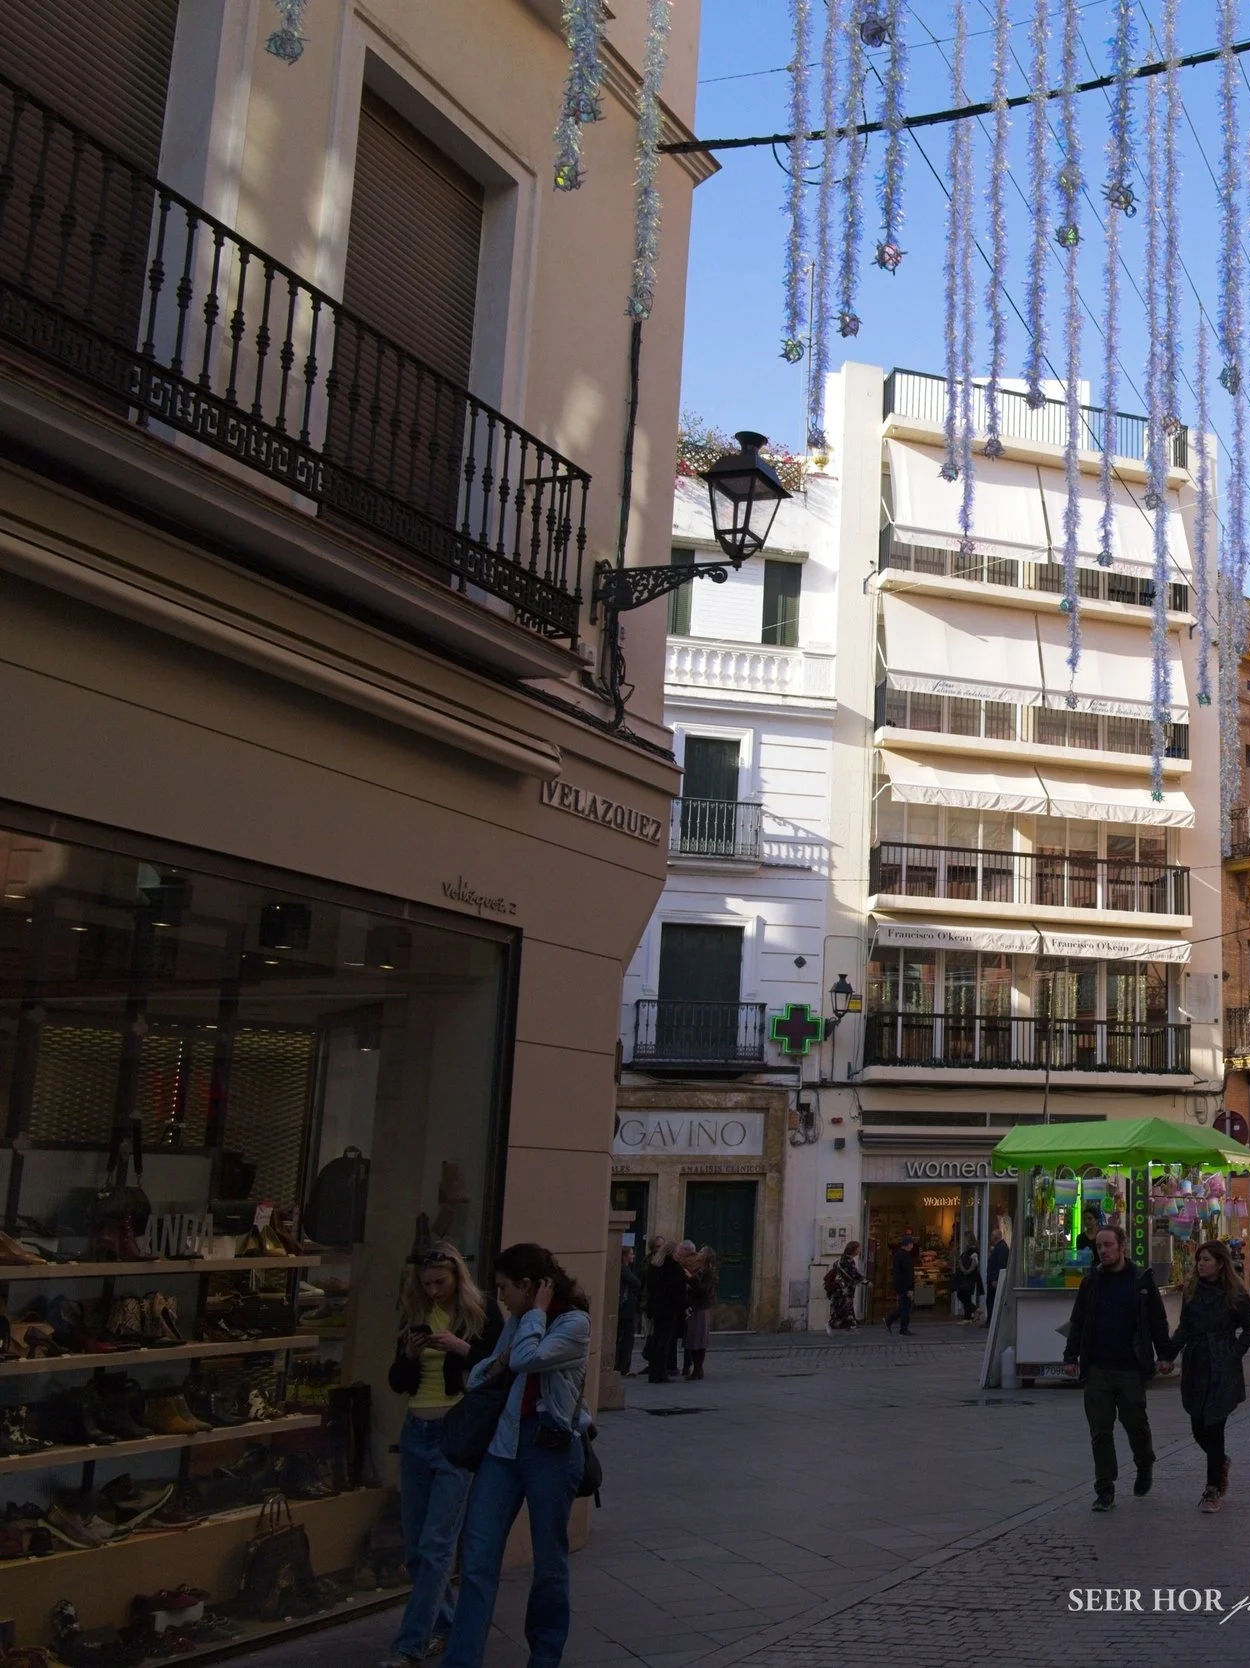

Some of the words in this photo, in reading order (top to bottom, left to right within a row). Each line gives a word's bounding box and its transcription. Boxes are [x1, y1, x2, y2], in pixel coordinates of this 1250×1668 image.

[546, 780, 661, 842] VELAZQUEZ
[888, 928, 934, 940] Francisco
[937, 931, 972, 942] O'kean
[1052, 938, 1095, 949] Francisco
[1097, 941, 1129, 952] O'kean
[619, 1119, 747, 1147] GAVIÑO
